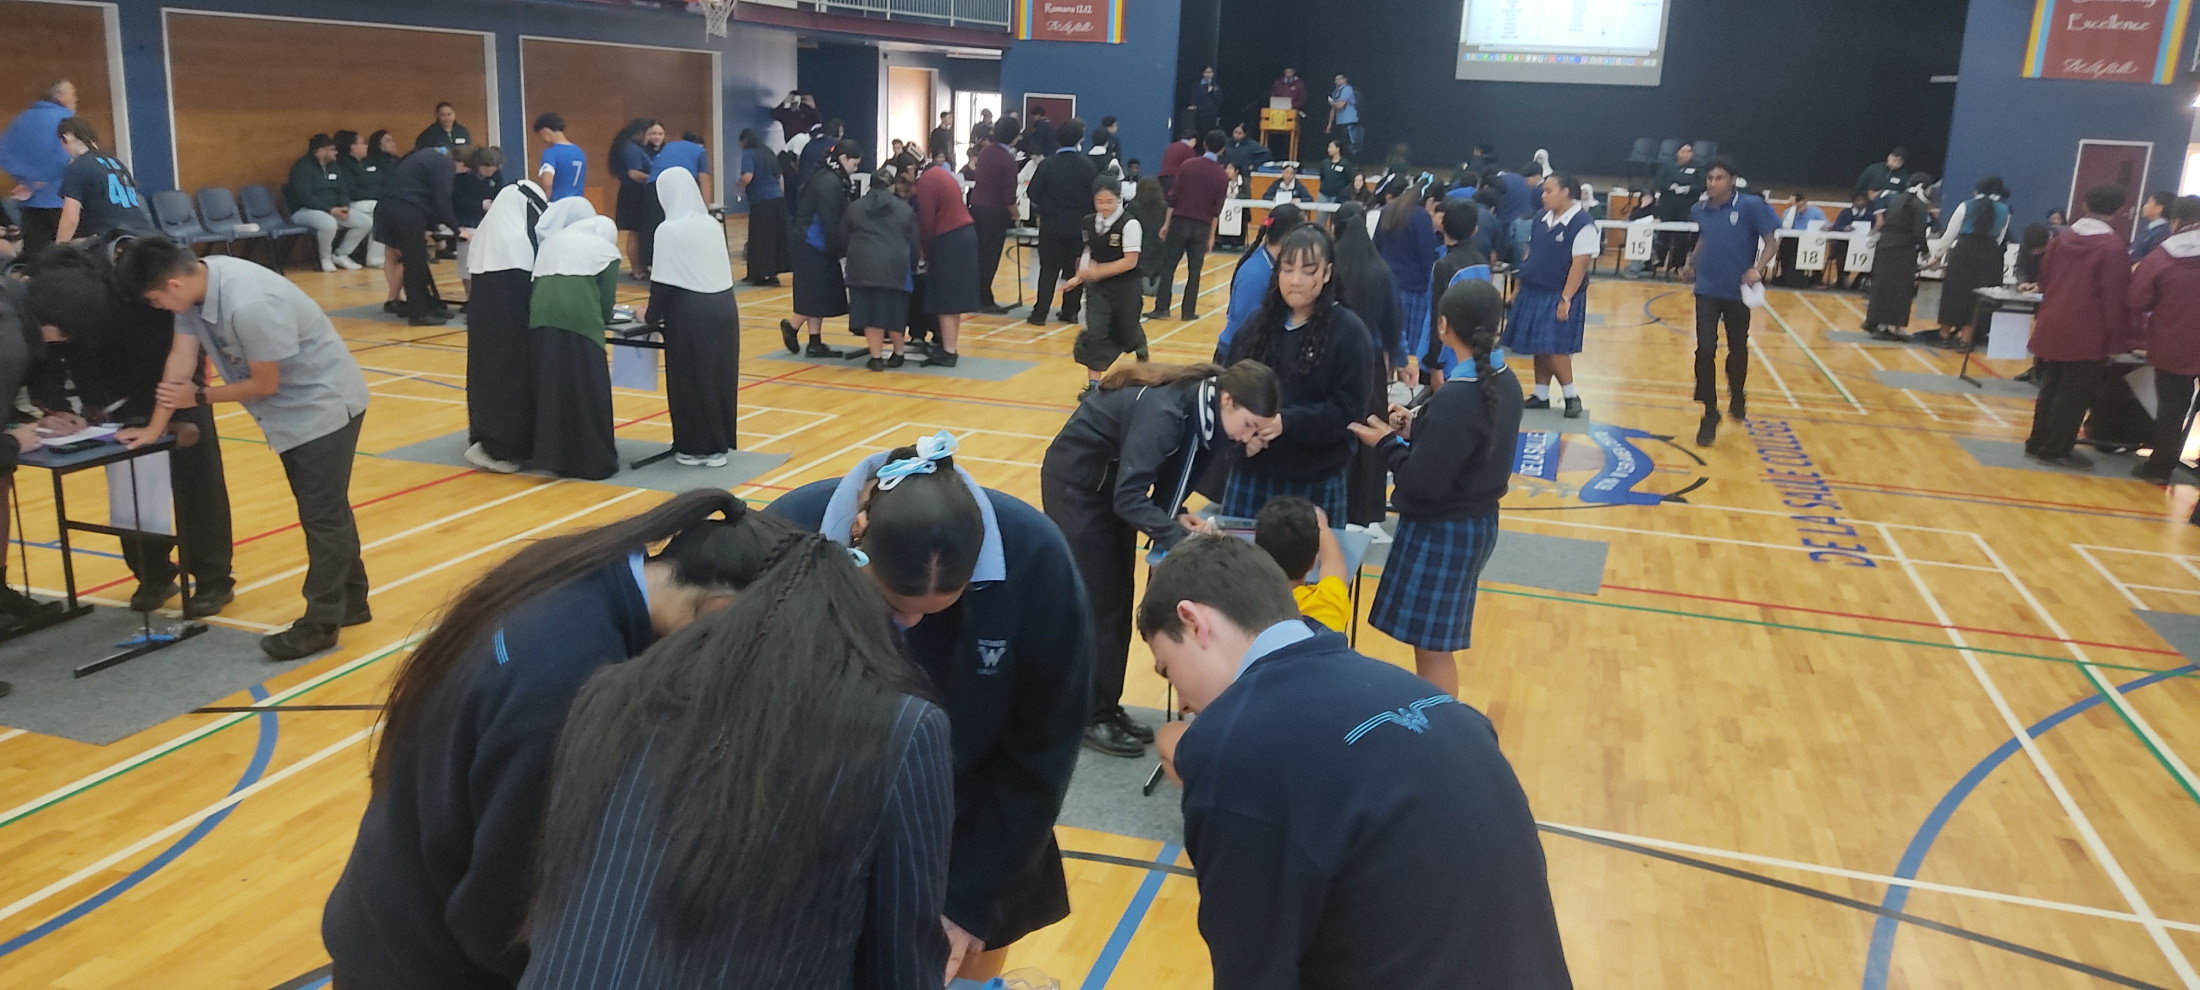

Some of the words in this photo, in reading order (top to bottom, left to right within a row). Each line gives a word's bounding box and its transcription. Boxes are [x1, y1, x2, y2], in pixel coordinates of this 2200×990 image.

[2066, 12, 2151, 31] Excellence
[572, 160, 583, 187] 7
[1224, 208, 1233, 222] 8
[1631, 241, 1646, 255] 15
[1802, 250, 1818, 265] 18
[1853, 253, 1869, 266] 19
[1743, 418, 1813, 467] COLLEGE
[1519, 463, 1543, 477] DE
[1767, 468, 1843, 510] SALLE
[1790, 515, 1858, 537] LA
[1802, 538, 1877, 568] DE
